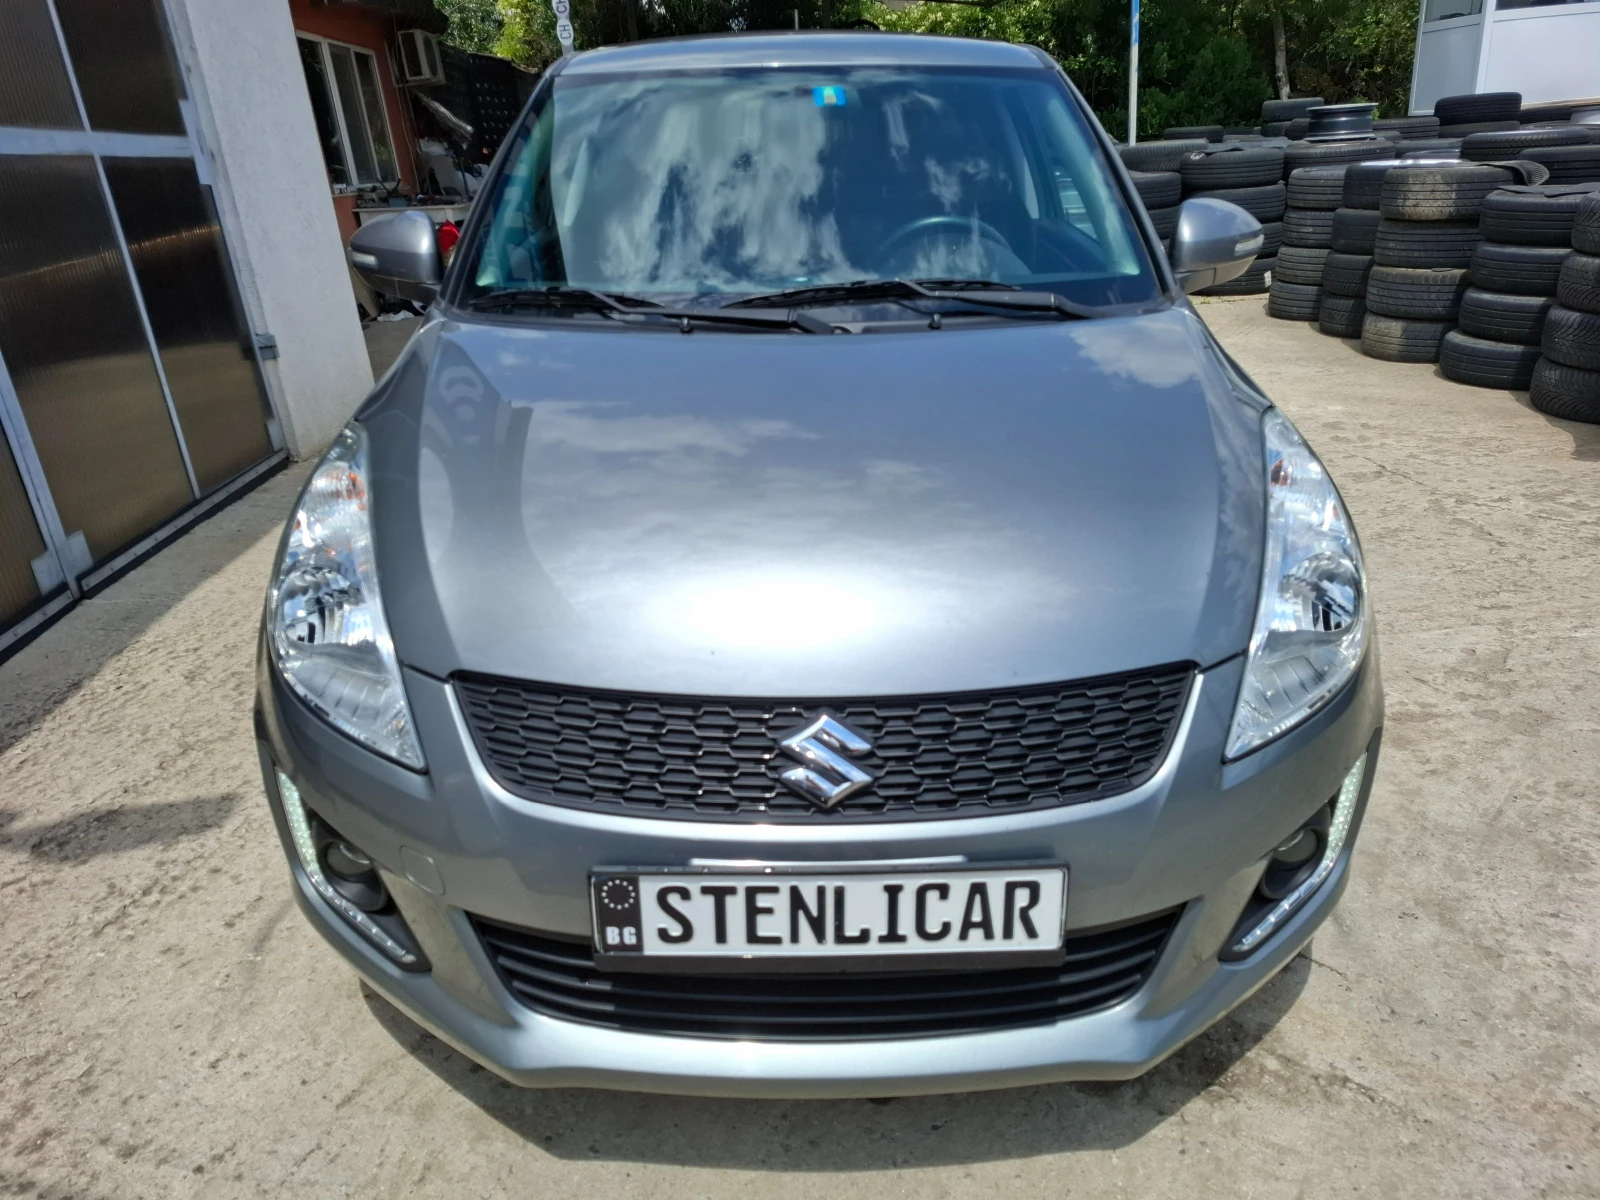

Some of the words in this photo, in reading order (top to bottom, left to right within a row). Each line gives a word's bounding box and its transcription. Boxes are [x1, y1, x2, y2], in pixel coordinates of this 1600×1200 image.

[558, 24, 572, 40] CH
[656, 880, 1041, 945] STENLICAR
[605, 926, 638, 946] BG
